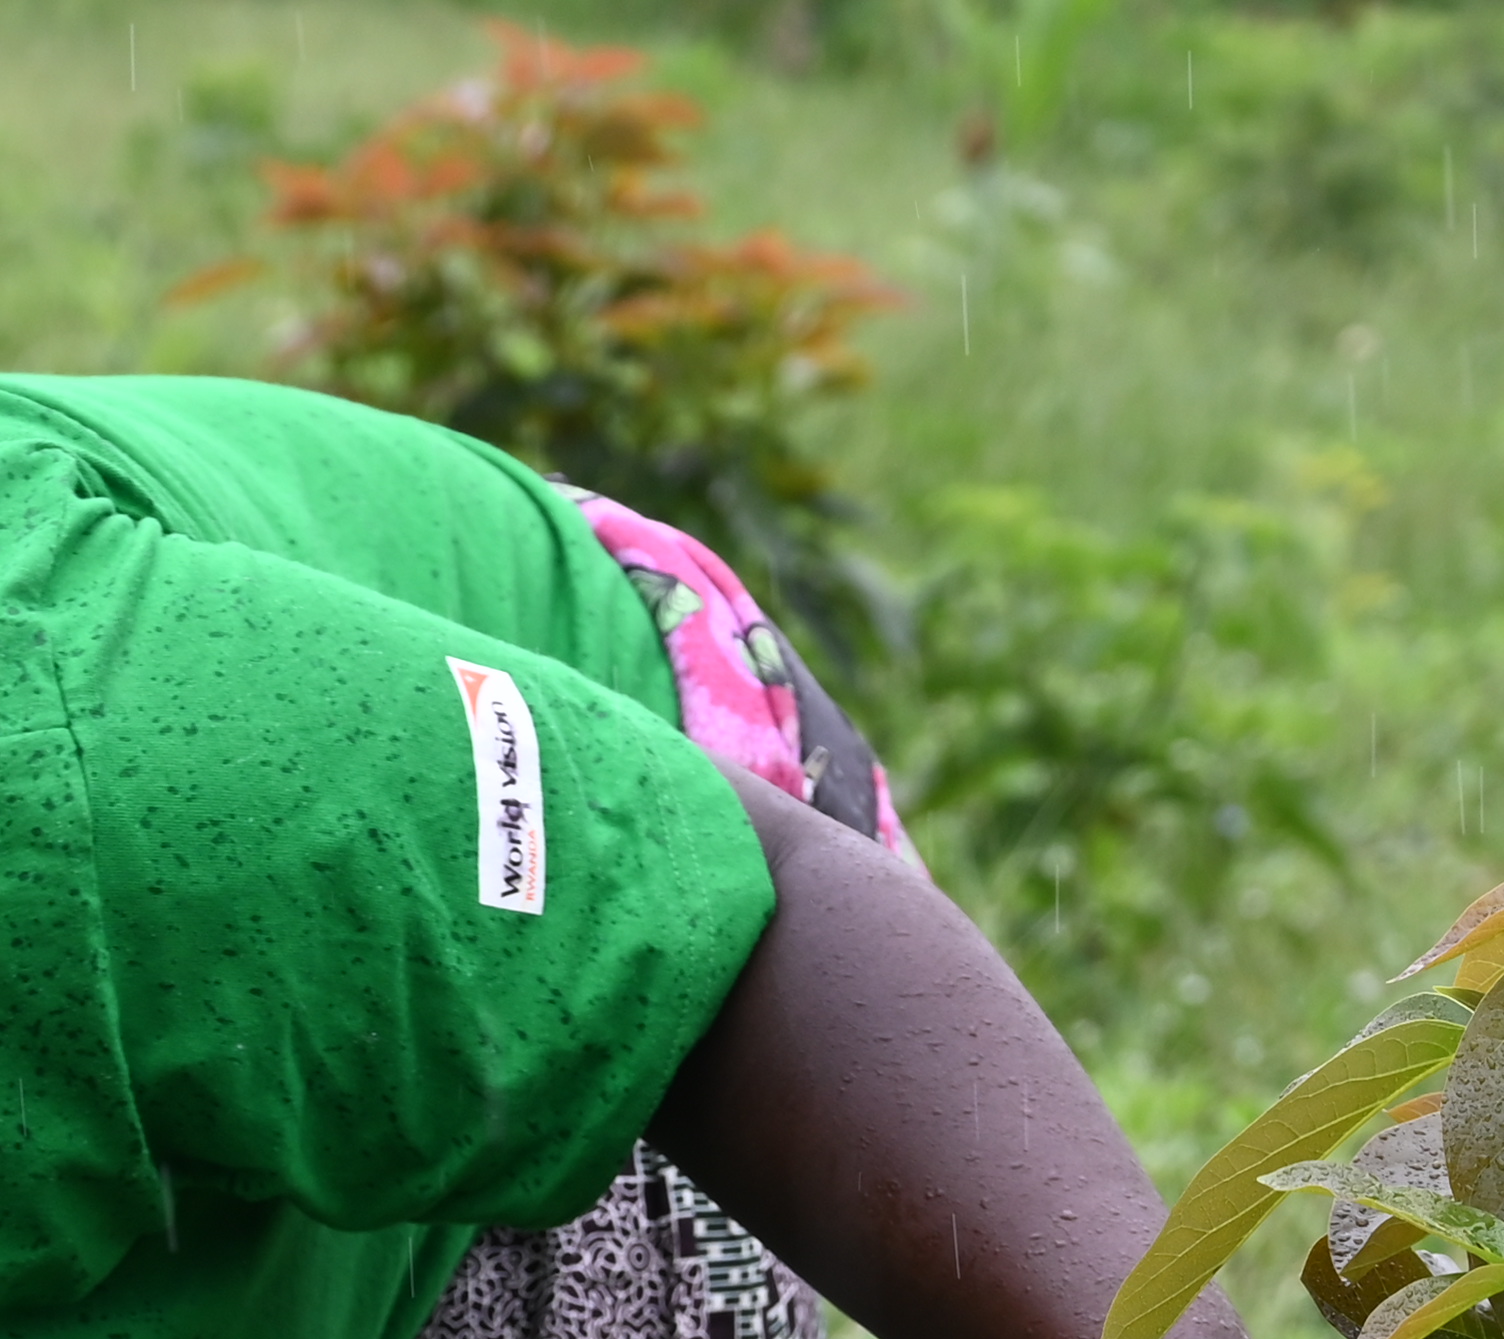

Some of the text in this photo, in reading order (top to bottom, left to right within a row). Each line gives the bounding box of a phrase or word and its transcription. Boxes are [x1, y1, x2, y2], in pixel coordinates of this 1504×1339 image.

[491, 701, 524, 898] World Vision
[526, 830, 538, 901] RWANDA
